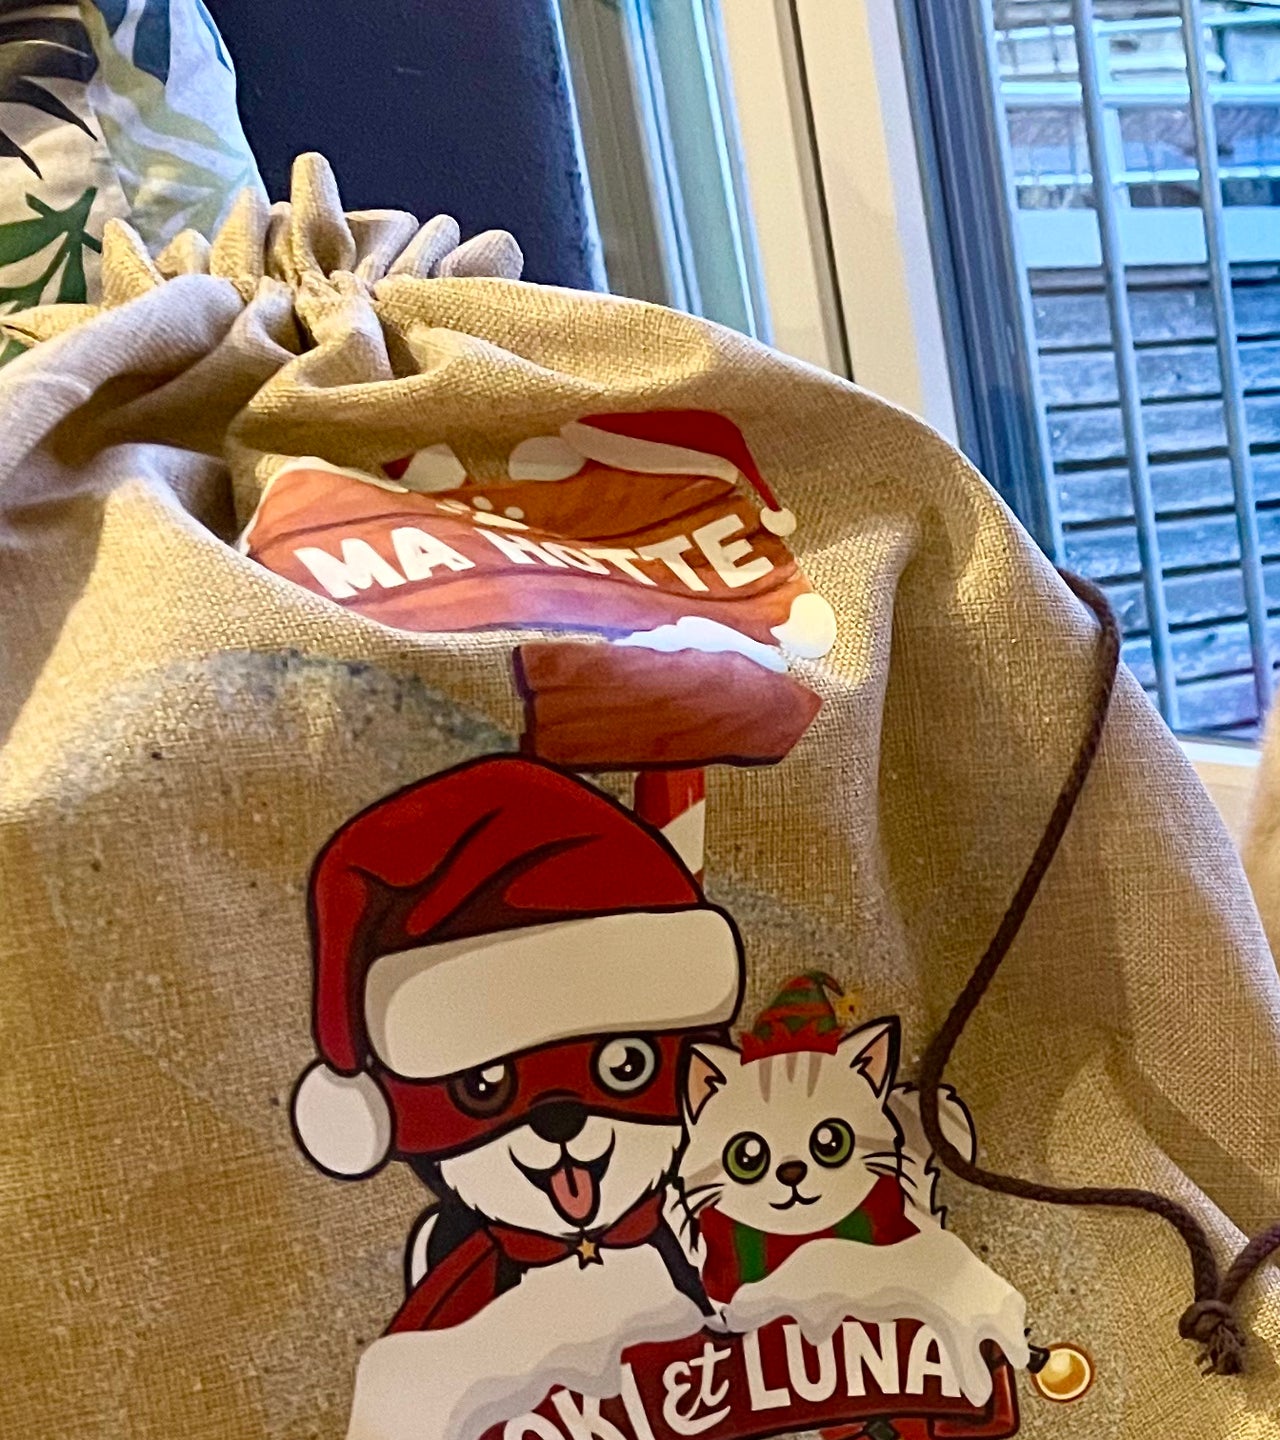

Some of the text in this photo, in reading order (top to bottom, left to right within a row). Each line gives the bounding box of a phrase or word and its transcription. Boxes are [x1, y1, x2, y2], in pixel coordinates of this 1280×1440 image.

[294, 514, 774, 597] MA HOTTE
[662, 1342, 732, 1438] et
[742, 1321, 960, 1410] LUNA
